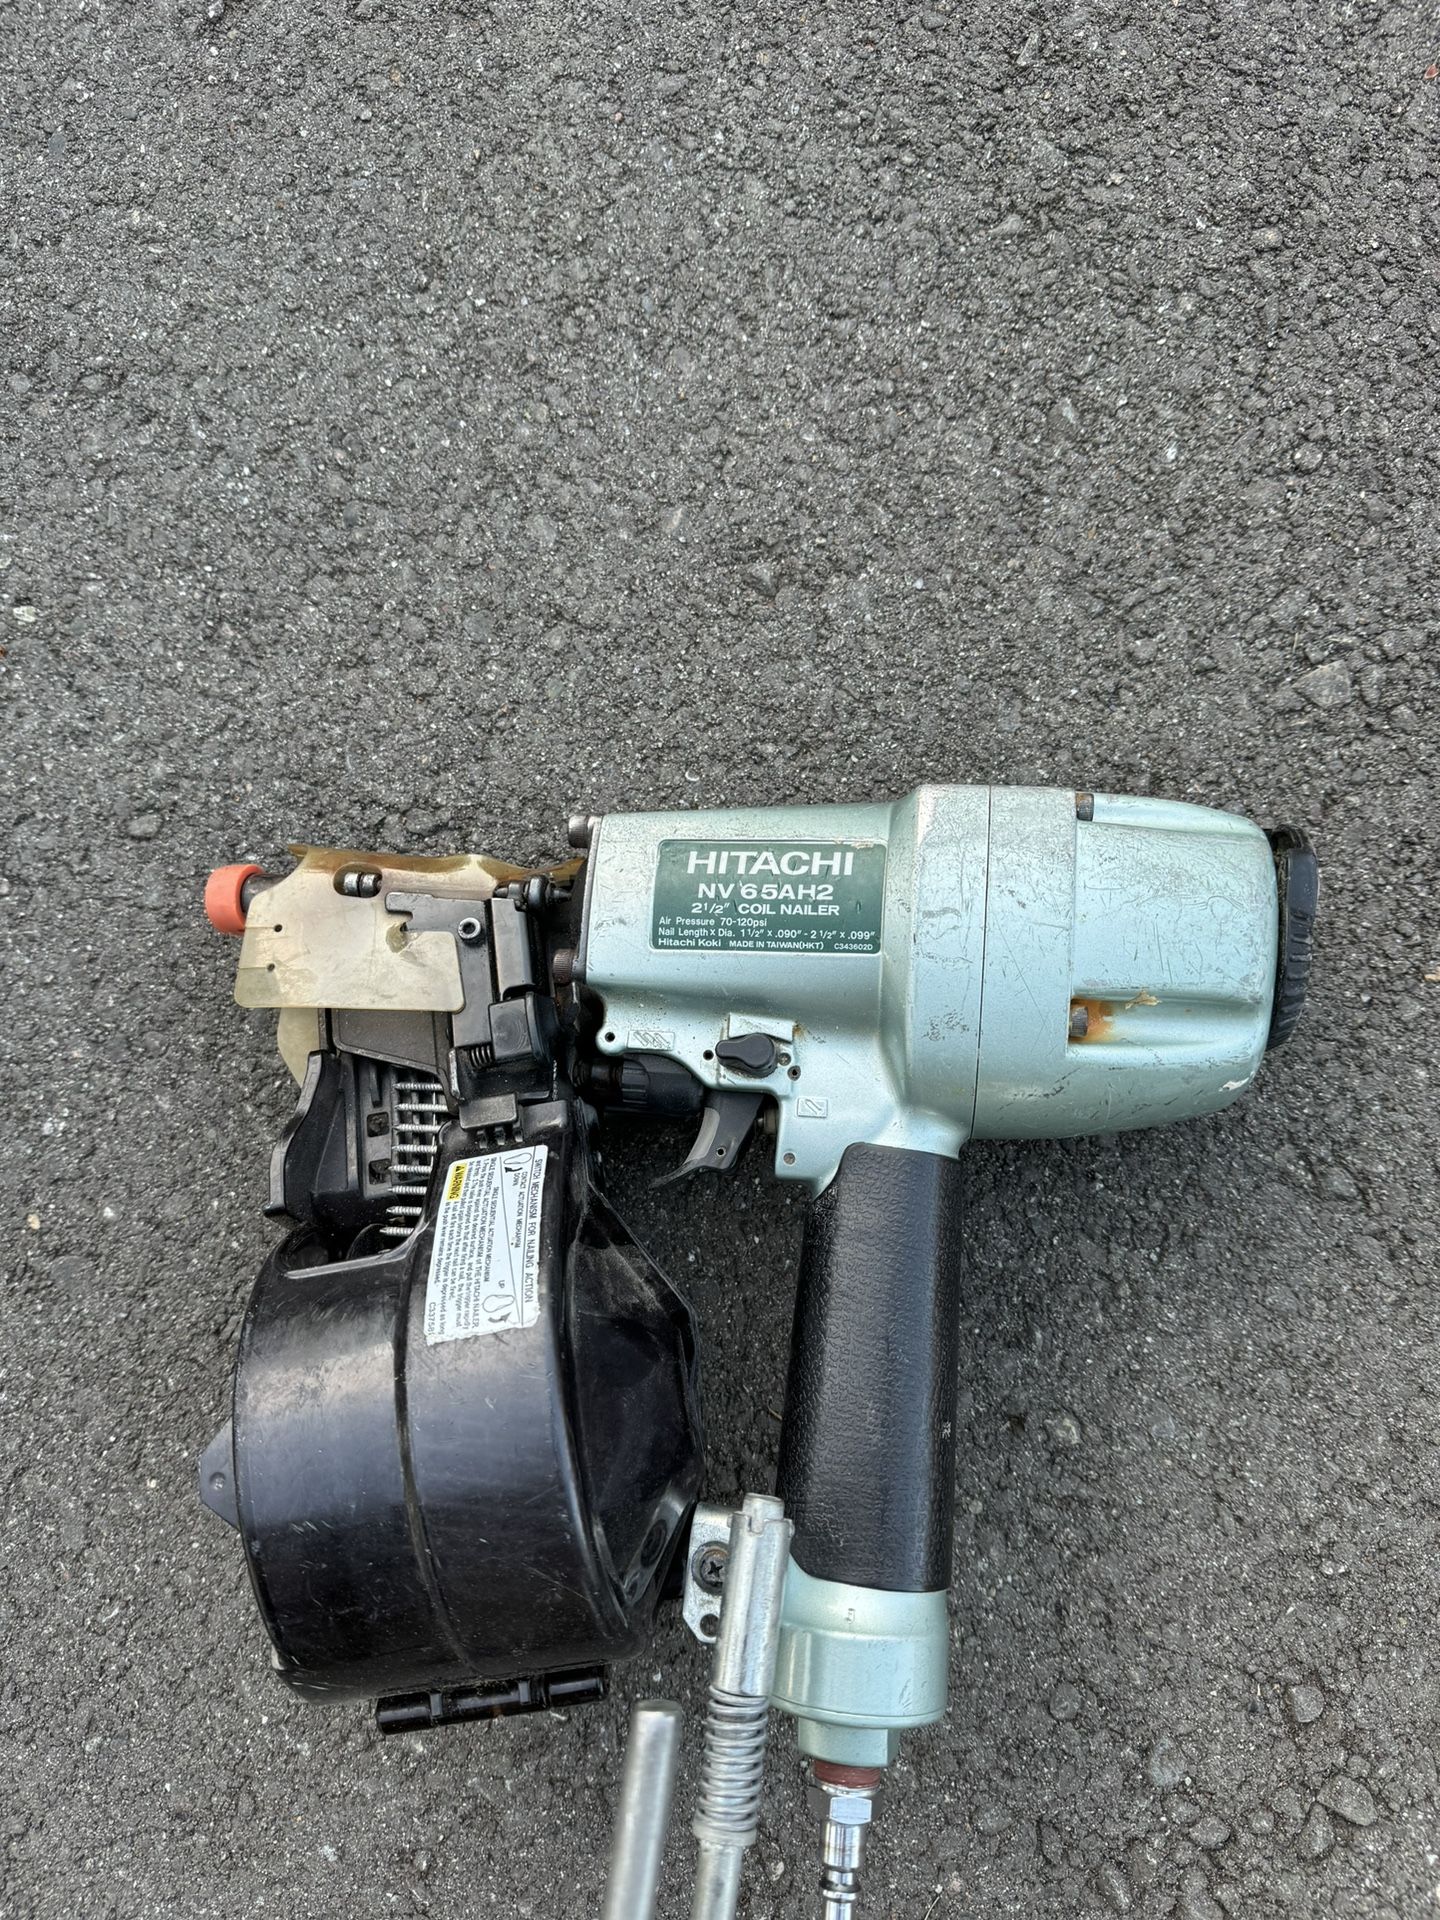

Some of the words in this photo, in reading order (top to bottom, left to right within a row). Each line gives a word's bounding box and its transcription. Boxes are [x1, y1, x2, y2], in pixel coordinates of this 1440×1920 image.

[687, 851, 854, 875] HITACHI
[738, 904, 776, 915] COIL
[780, 904, 840, 915] NAILER
[659, 916, 671, 925] Air
[676, 917, 715, 925] Pressure
[720, 918, 767, 928] 70-120psi
[658, 928, 675, 936] Nail
[678, 928, 708, 938] Length
[718, 928, 735, 937] Dia.
[658, 938, 695, 946] Hitachi
[698, 939, 721, 947] Koki
[533, 1159, 543, 1179] SWITCH
[450, 1171, 464, 1199] WARNING
[512, 1173, 520, 1186] DOWN
[529, 1182, 539, 1218] MECHANISM
[528, 1222, 536, 1236] FOR
[526, 1240, 535, 1268] NAILING
[499, 1280, 505, 1288] UP
[525, 1273, 534, 1303] ACTION
